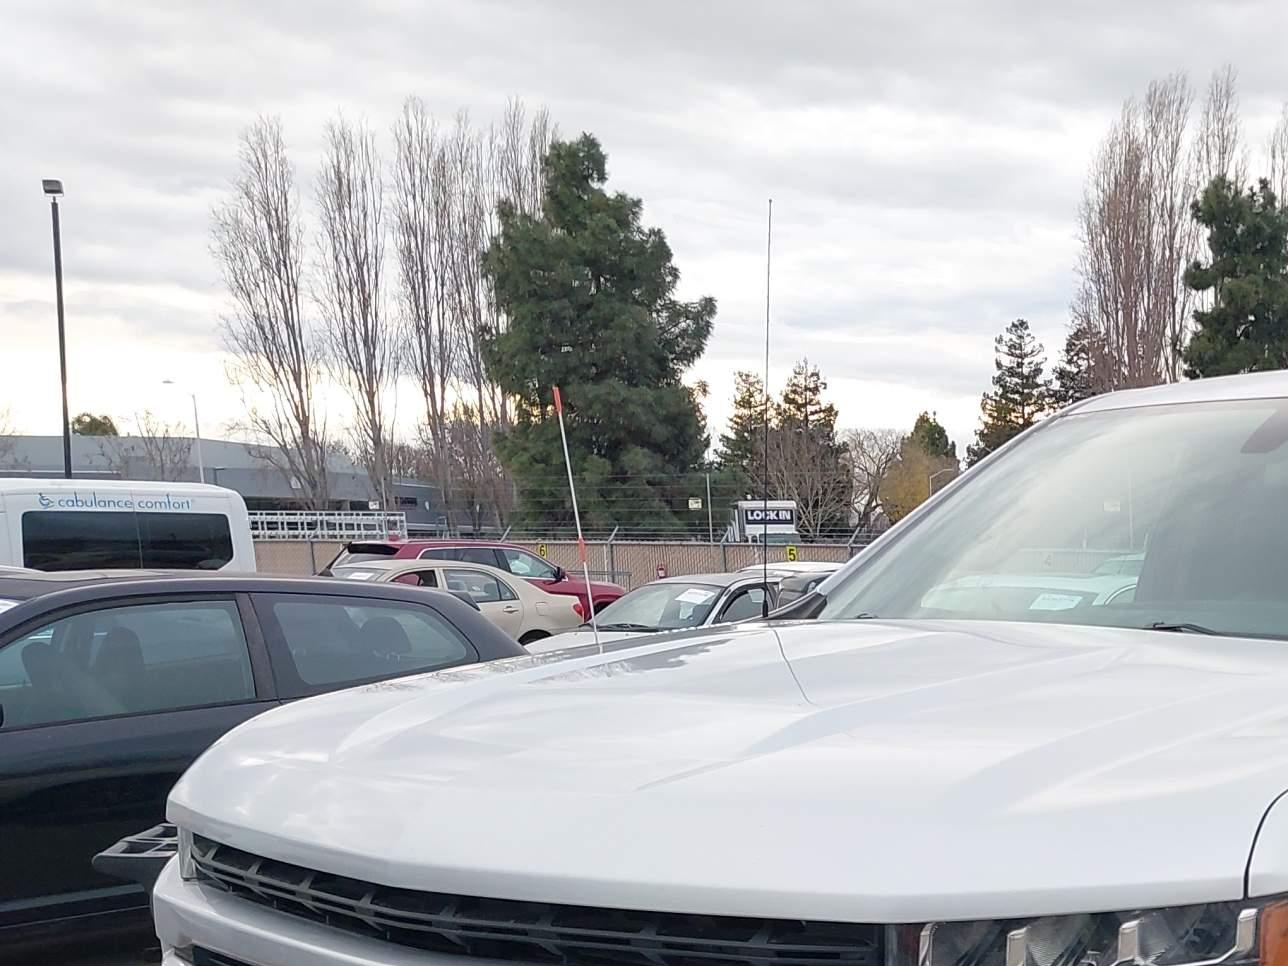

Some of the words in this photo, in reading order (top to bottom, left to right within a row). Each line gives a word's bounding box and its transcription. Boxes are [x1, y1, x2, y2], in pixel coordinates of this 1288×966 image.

[58, 492, 133, 509] cabulance
[138, 493, 191, 510] comfort
[747, 510, 778, 520] LOCK
[779, 510, 791, 520] IN
[540, 545, 546, 557] 6
[788, 548, 796, 561] 5
